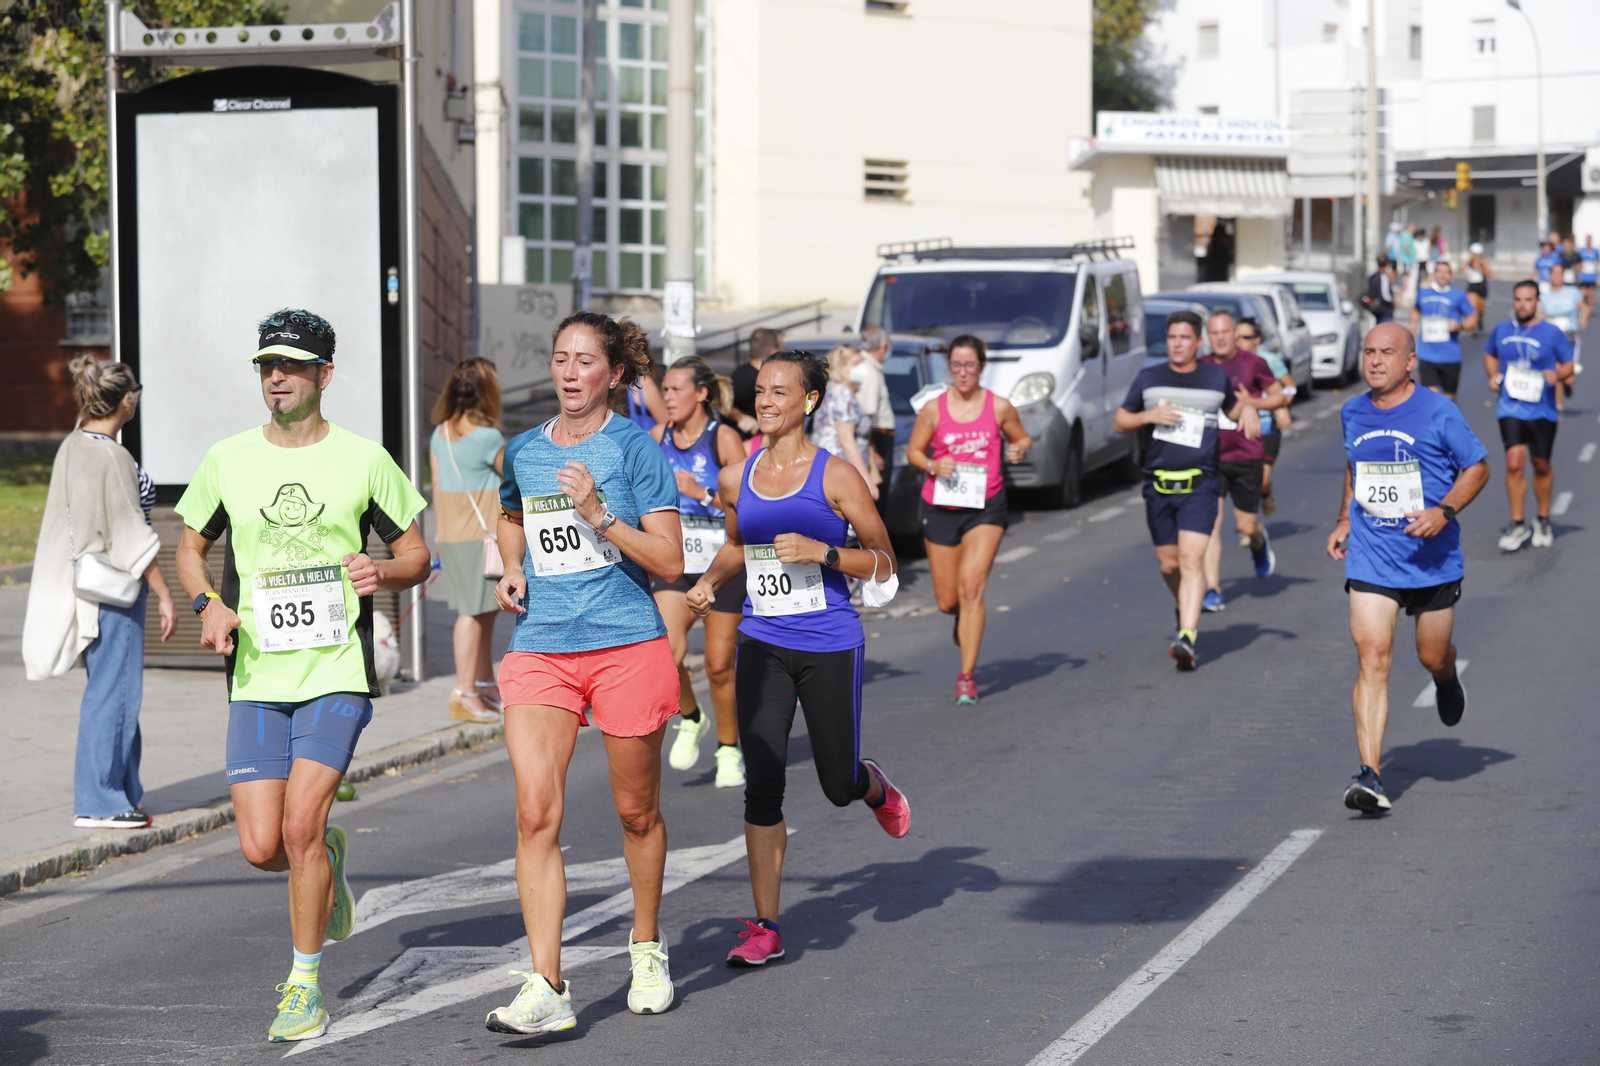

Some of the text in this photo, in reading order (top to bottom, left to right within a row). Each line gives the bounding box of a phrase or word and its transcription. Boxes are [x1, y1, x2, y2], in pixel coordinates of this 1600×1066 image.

[228, 98, 291, 110] Clear Channel
[1145, 130, 1285, 143] PATATAS FRITAS
[265, 331, 301, 340] orca
[1368, 464, 1387, 474] VUELTA
[1387, 464, 1392, 474] A
[1392, 463, 1415, 474] HUELVA
[1368, 486, 1398, 504] 256
[534, 499, 559, 512] VUELTA
[560, 498, 567, 508] A
[540, 525, 580, 554] 650
[754, 548, 776, 559] VUELTA
[258, 570, 335, 588] 34 VUELTA A HUELVA
[758, 572, 792, 596] 330
[265, 586, 310, 597] JUAN MANUEL
[270, 600, 315, 629] 635
[228, 766, 258, 776] LURBEL
